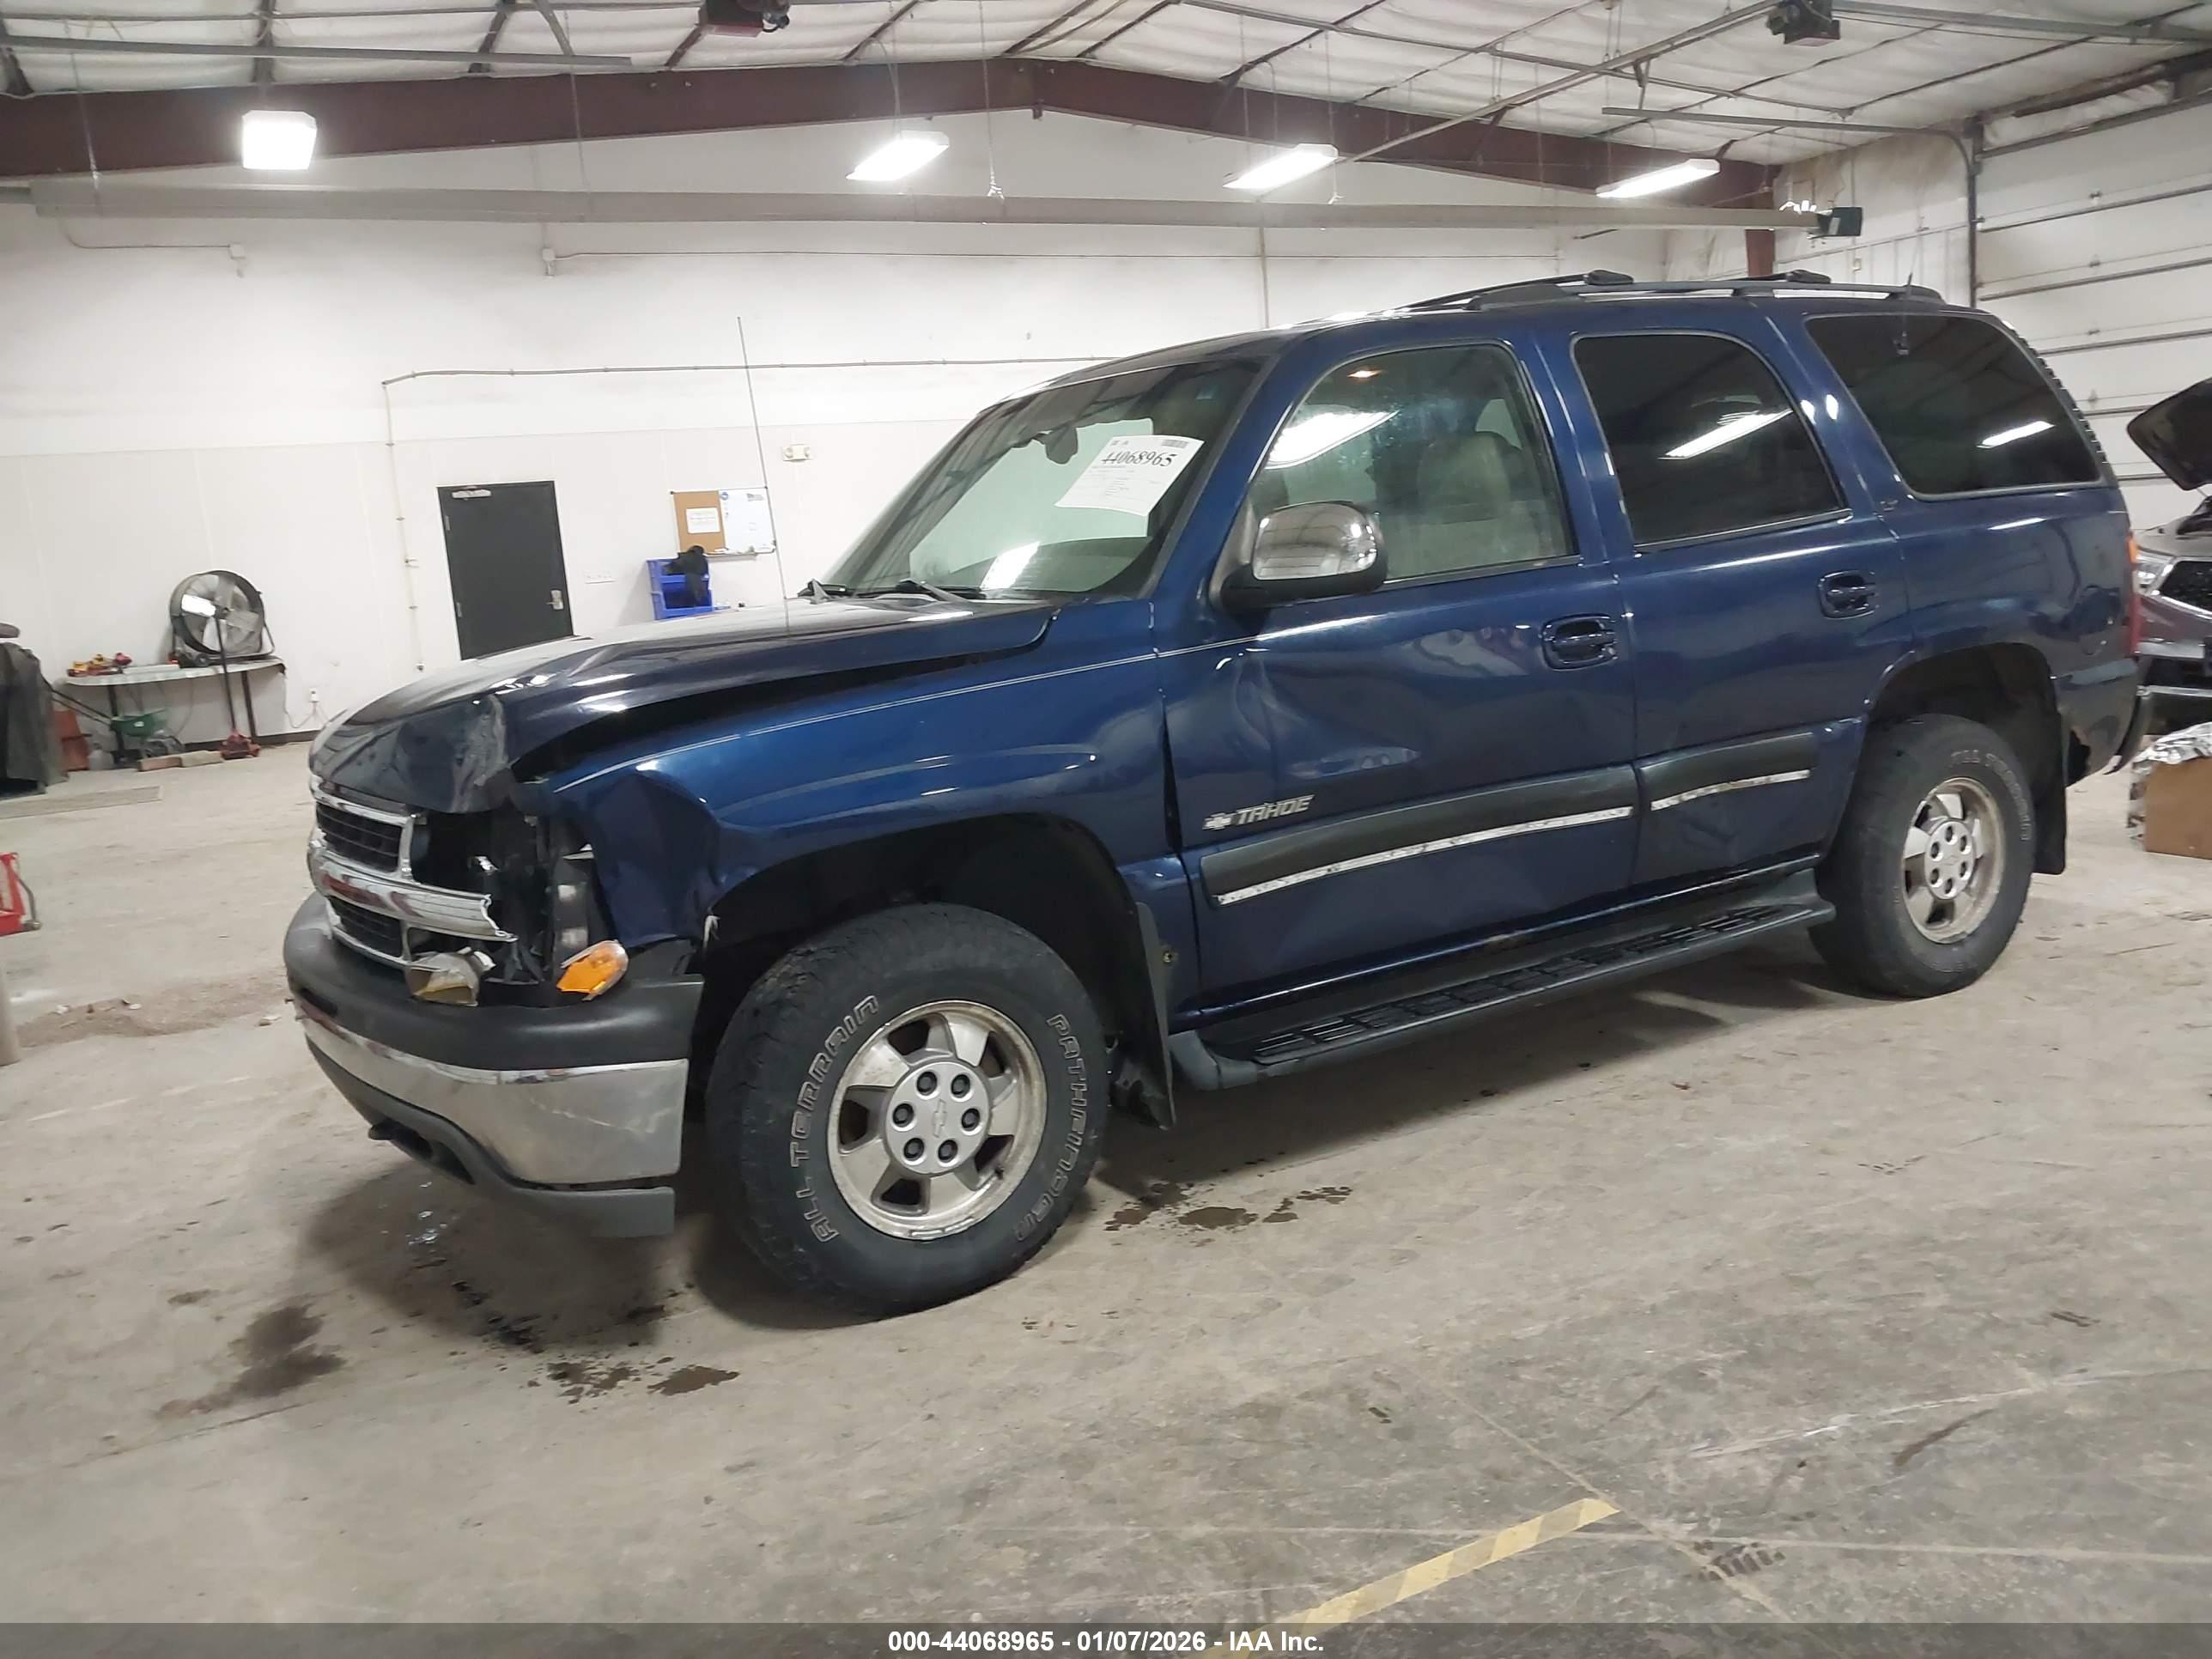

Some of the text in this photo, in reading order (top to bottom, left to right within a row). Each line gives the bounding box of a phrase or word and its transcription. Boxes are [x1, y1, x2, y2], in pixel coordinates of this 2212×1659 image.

[1101, 450, 1178, 467] 44068965
[1235, 794, 1315, 825] TAHOE
[790, 995, 879, 1243] ALL TERRAIN
[1014, 1013, 1088, 1242] PATHFINDER
